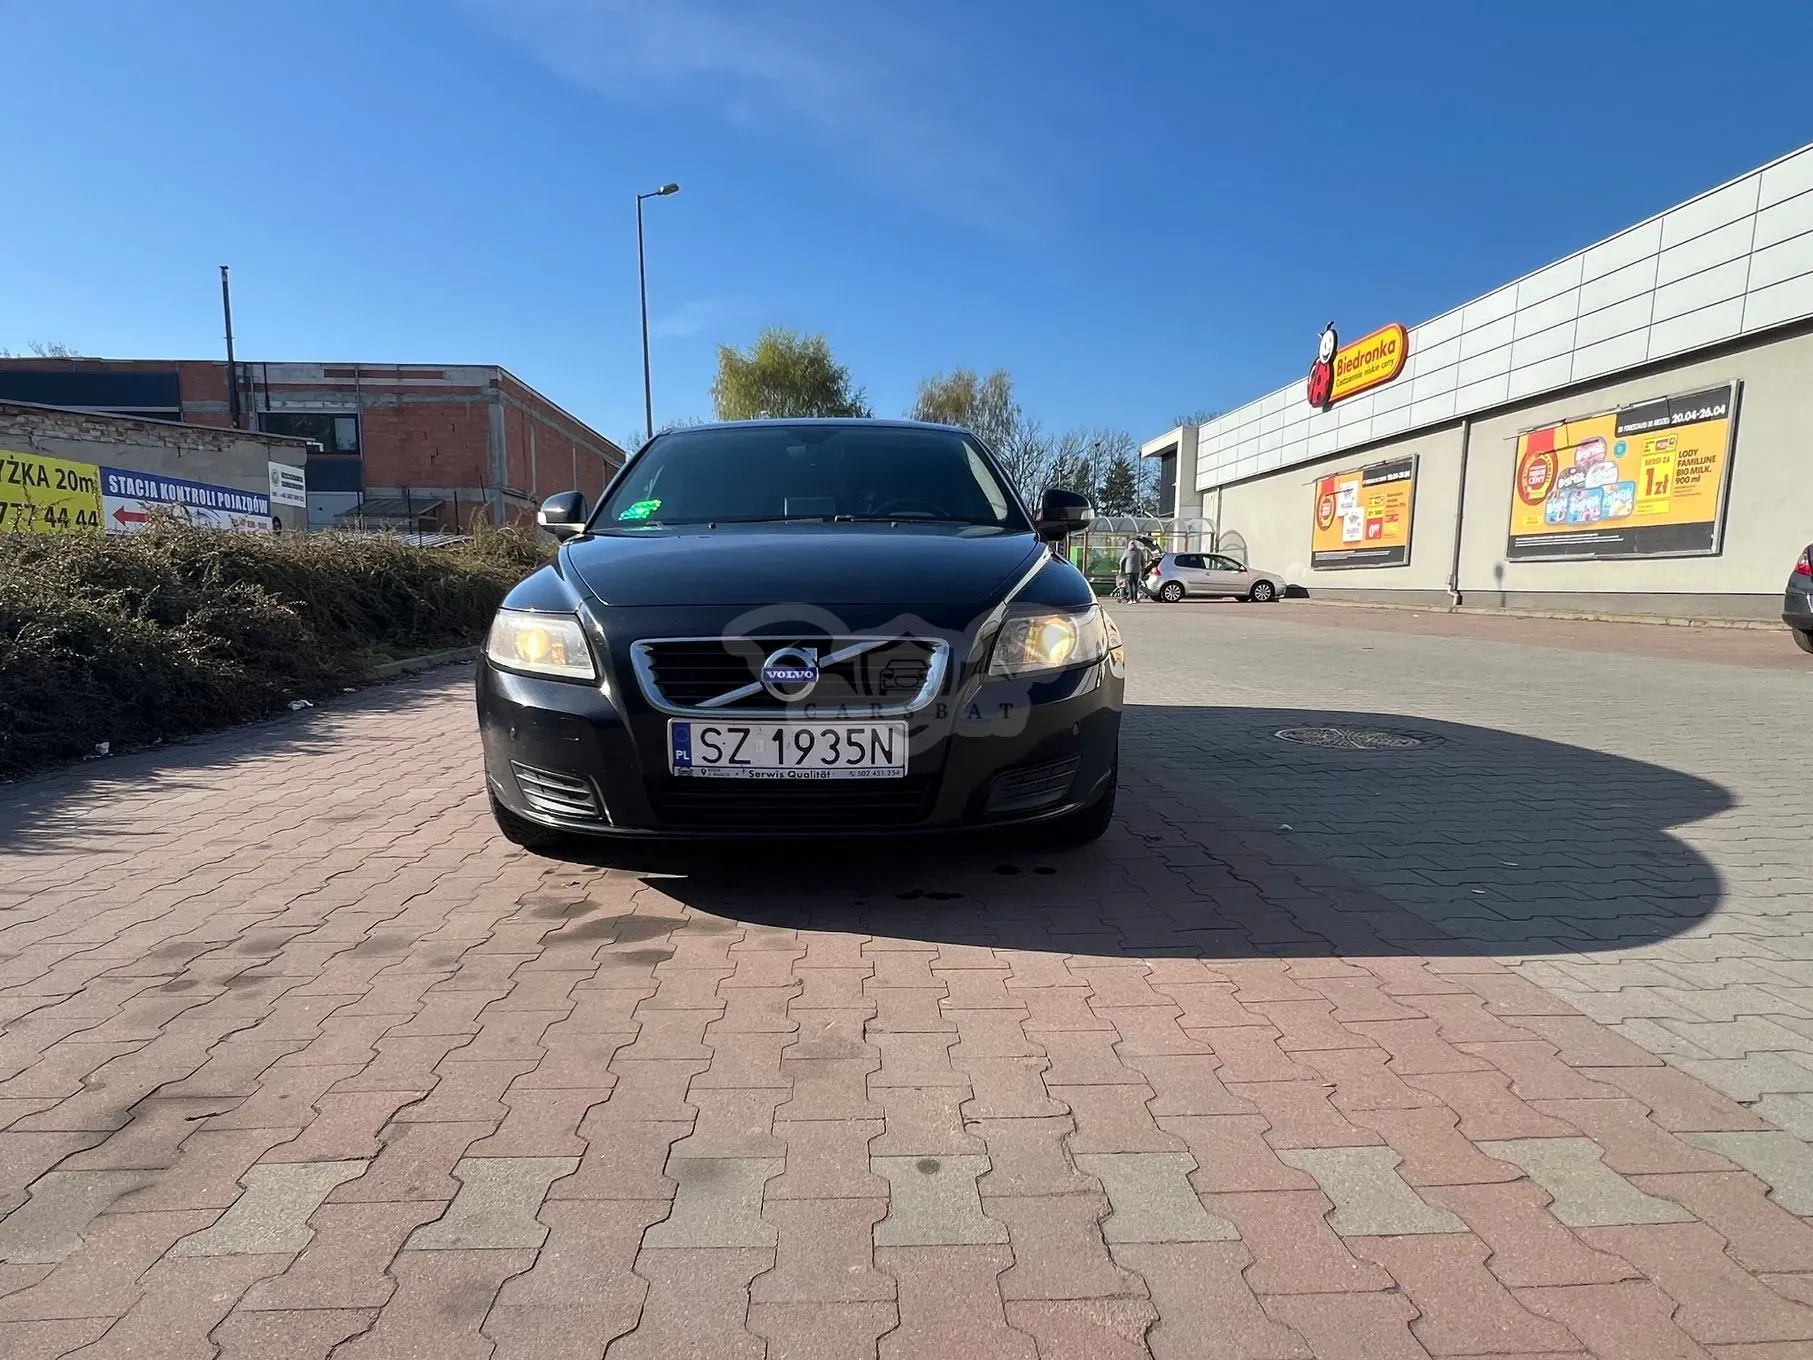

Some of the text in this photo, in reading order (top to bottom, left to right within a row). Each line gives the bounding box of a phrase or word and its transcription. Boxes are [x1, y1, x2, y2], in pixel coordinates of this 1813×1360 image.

[1337, 339, 1396, 377] Biedronka
[1671, 404, 1726, 425] 20.04-26.04
[1678, 448, 1699, 459] LODY
[1676, 468, 1689, 477] BIG
[1675, 476, 1690, 485] 900
[108, 475, 158, 498] STACJA
[160, 483, 216, 507] KONTROLI
[217, 492, 268, 514] POJAZDÓW
[766, 669, 814, 680] VOLVO
[700, 727, 893, 765] SZ 1935N
[675, 750, 690, 760] PL
[748, 769, 831, 779] Serwis Qualität
